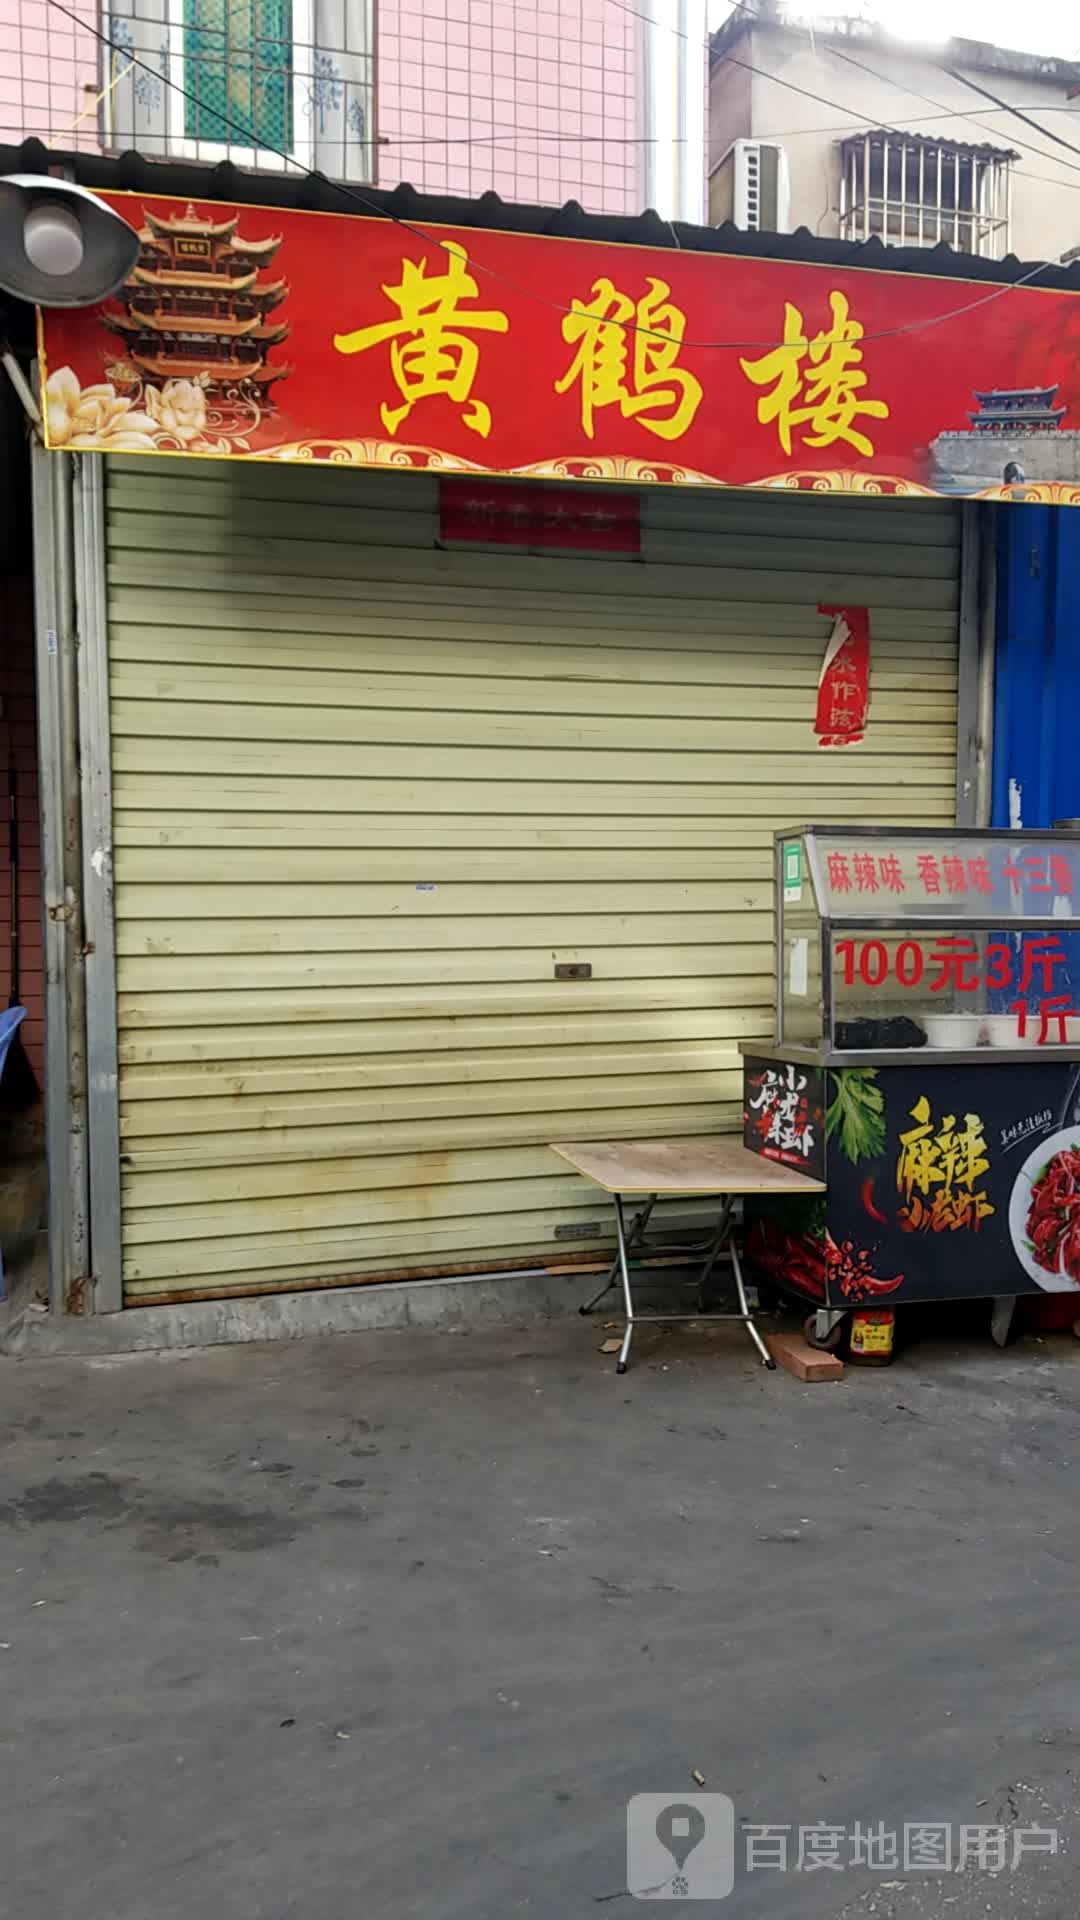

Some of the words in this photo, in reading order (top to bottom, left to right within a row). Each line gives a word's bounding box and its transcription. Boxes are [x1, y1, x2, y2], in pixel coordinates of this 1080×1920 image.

[334, 240, 889, 457] 黄鹤楼
[826, 851, 906, 894] 麻辣味
[916, 854, 996, 895] 香辣味
[835, 936, 1067, 993] 100元3斤
[1010, 995, 1079, 1046] 1斤
[896, 1095, 990, 1205] 麻辣
[896, 1189, 995, 1233] 小龙虾
